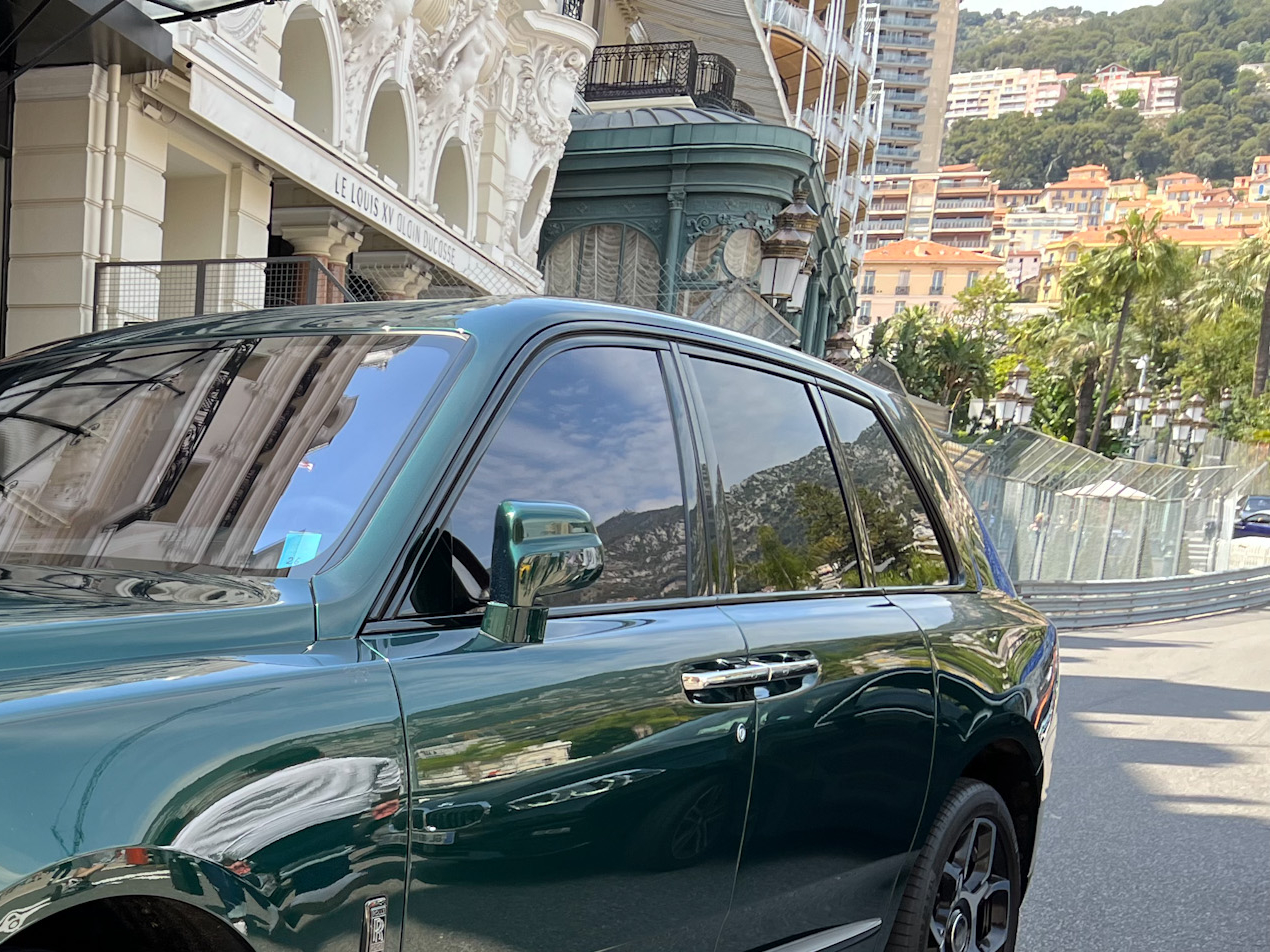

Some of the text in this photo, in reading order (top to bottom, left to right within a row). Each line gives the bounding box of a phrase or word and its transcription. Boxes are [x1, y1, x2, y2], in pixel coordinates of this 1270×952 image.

[334, 173, 347, 199] LE
[351, 182, 379, 217] LOUIS
[381, 202, 395, 226] XV
